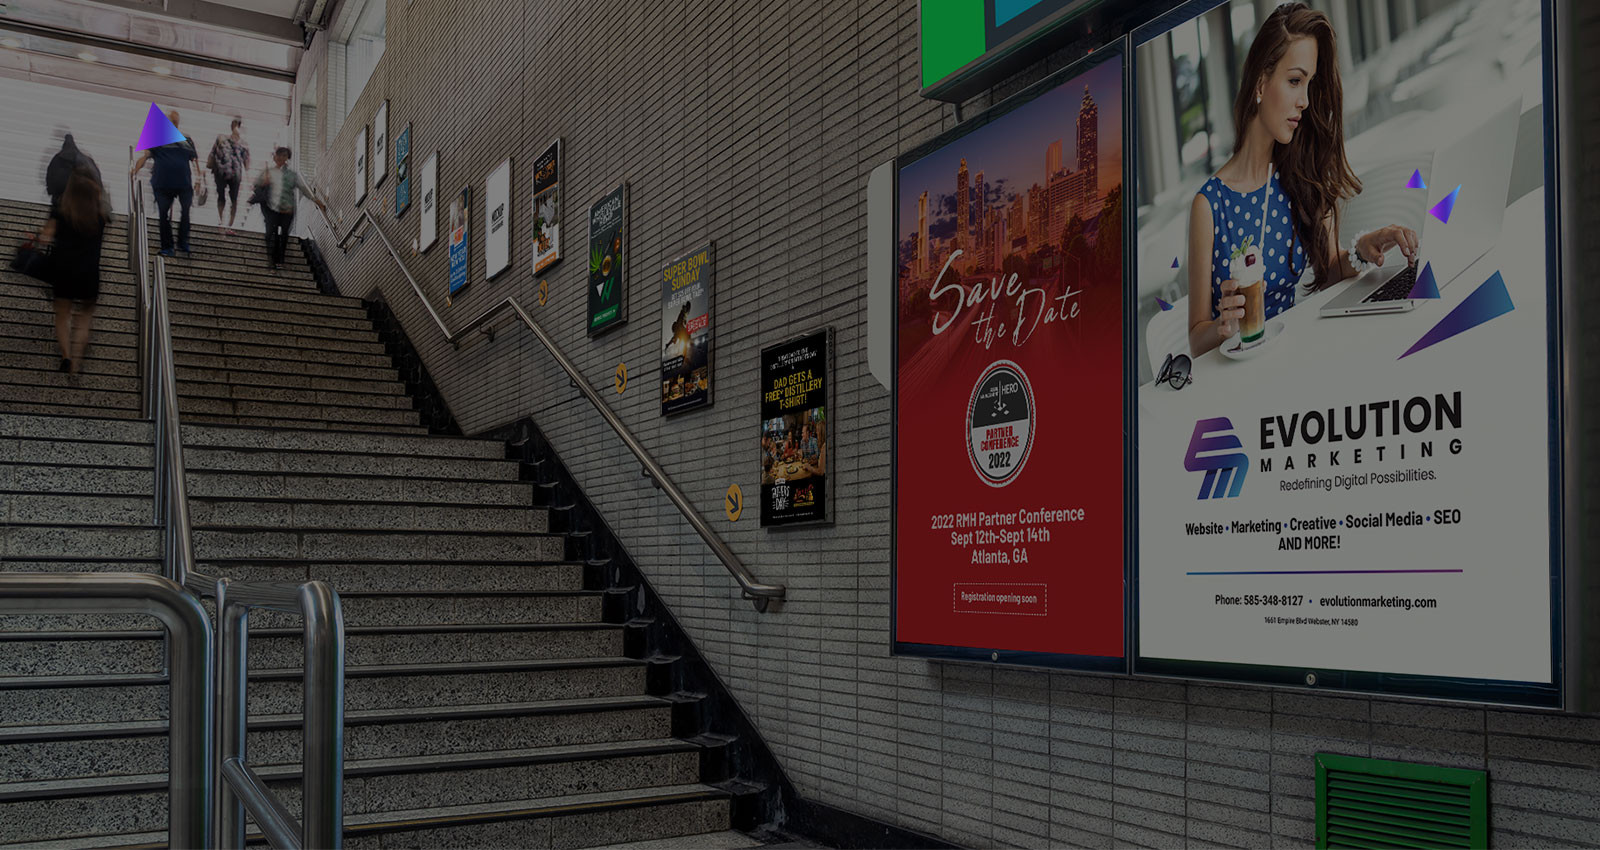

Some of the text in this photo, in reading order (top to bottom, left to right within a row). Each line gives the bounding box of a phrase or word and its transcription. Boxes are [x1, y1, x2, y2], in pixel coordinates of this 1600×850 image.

[663, 250, 709, 283] SUPER BOWL
[671, 267, 700, 292] SUNDAY
[929, 249, 1023, 335] Save
[971, 285, 1084, 351] the Date
[773, 369, 813, 390] DAD GETS A
[784, 376, 823, 398] DISTILLERY
[1001, 381, 1019, 395] HERO
[779, 393, 807, 410] T-SHIRT!
[1259, 391, 1462, 450] EVOLUTION
[986, 425, 1014, 441] PARTNER
[980, 436, 1020, 452] CONFERENCE
[988, 451, 1011, 469] 2022
[1260, 438, 1463, 473] MARKETING
[1279, 468, 1437, 492] Redefining Digital Possibilities.
[930, 507, 1085, 530] 2022 RMH Partner Conference
[1185, 509, 1462, 536] Website Marketing Creative Social Media SEO
[951, 527, 1051, 548] Sept 12th-Sept 14th
[1278, 535, 1341, 551] AND MORE!
[971, 548, 1029, 565] Atlanta, GA
[960, 591, 1038, 605] Registration opening soon
[1215, 594, 1437, 610] Phone: 585-348-8127 evolutionmarketing.com
[1277, 617, 1295, 626] Empire
[1296, 617, 1307, 625] Blvd
[1331, 618, 1340, 626] NY
[1341, 618, 1359, 626] 14580
